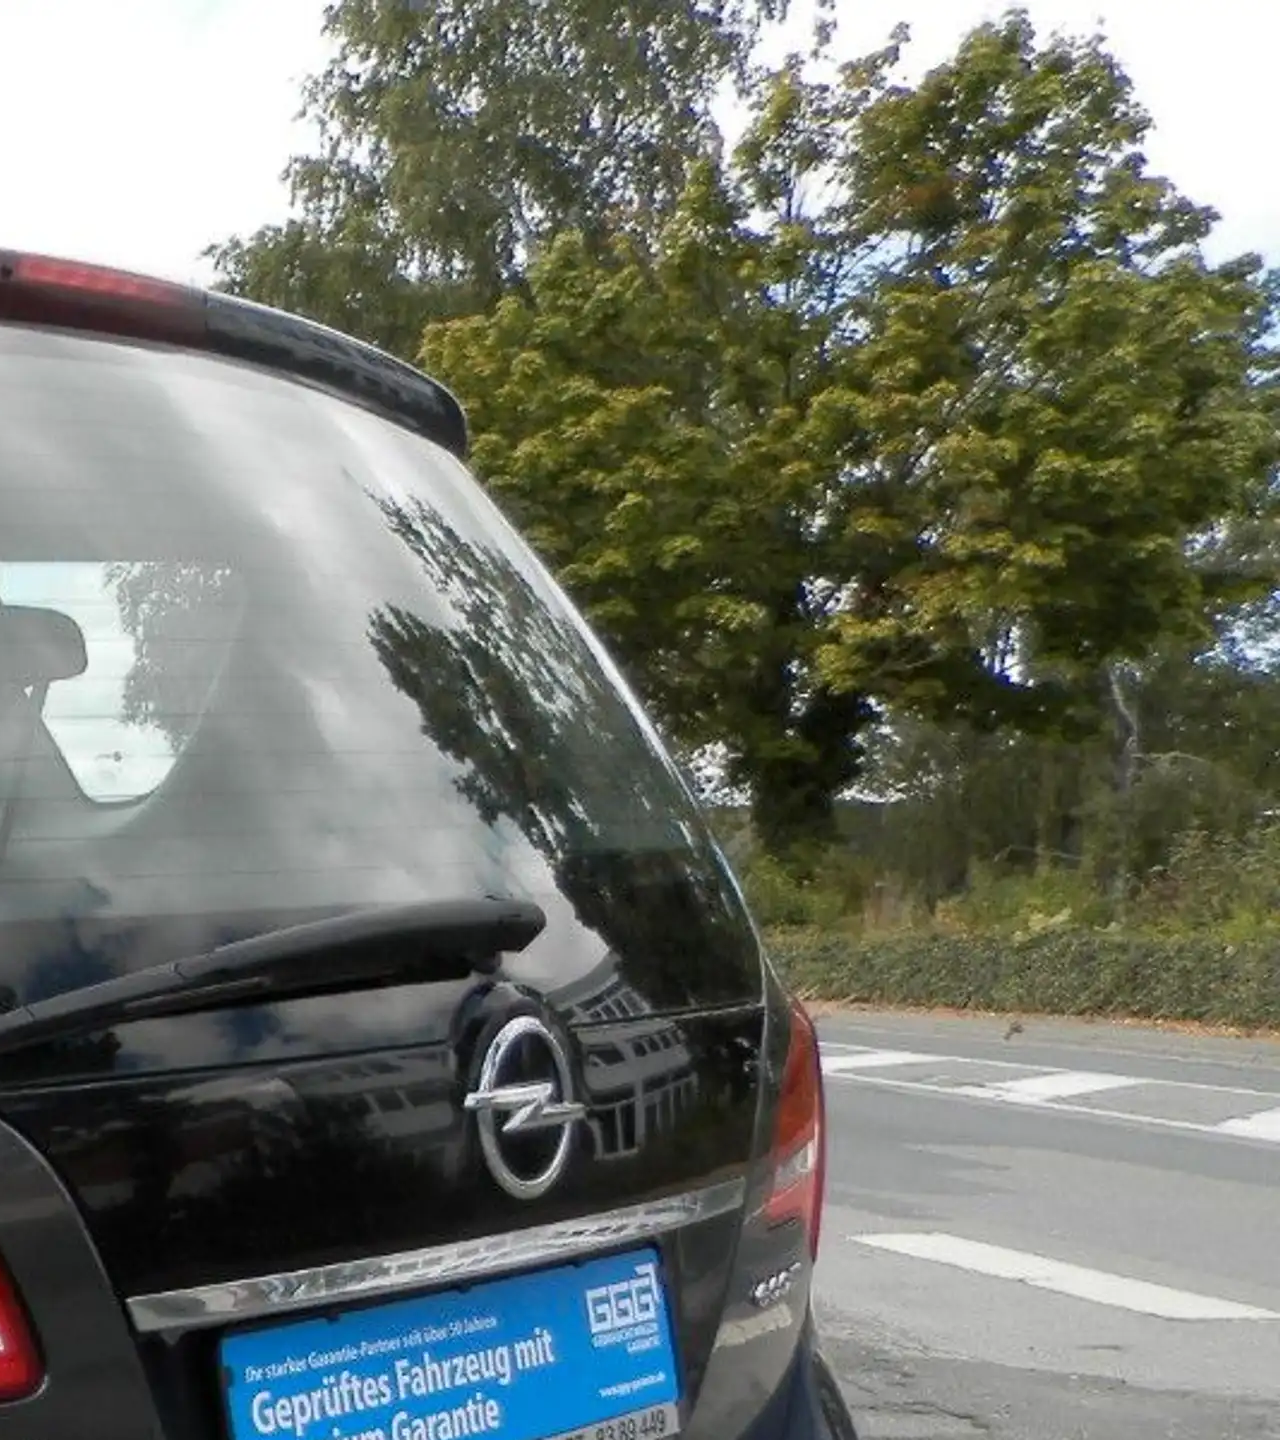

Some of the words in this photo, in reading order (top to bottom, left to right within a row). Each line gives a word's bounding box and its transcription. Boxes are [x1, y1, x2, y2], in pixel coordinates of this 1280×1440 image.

[251, 1370, 392, 1436] Geprüftes
[393, 1351, 512, 1400] Fahrzeug
[513, 1328, 556, 1370] mit
